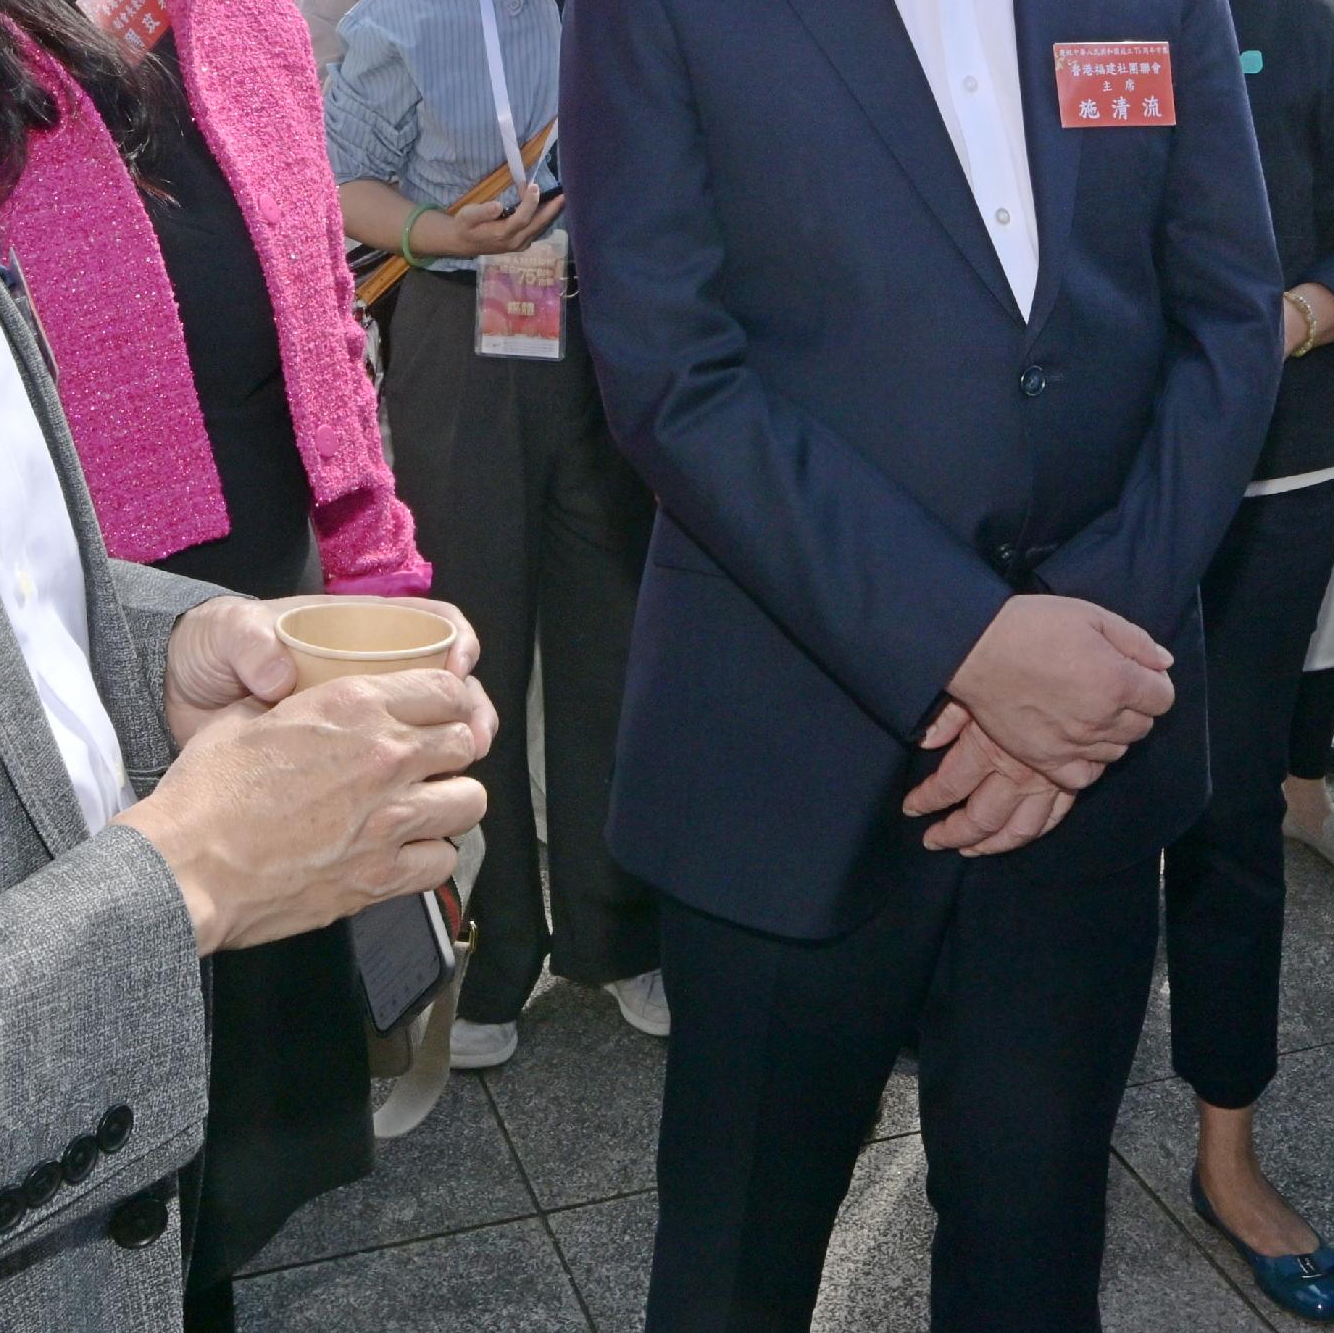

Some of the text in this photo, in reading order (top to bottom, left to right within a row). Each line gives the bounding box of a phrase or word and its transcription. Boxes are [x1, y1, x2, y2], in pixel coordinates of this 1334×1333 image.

[1071, 62, 1161, 77] 香港福建社團聯會
[1102, 78, 1135, 92] 主席
[1078, 95, 1162, 120] 施清流
